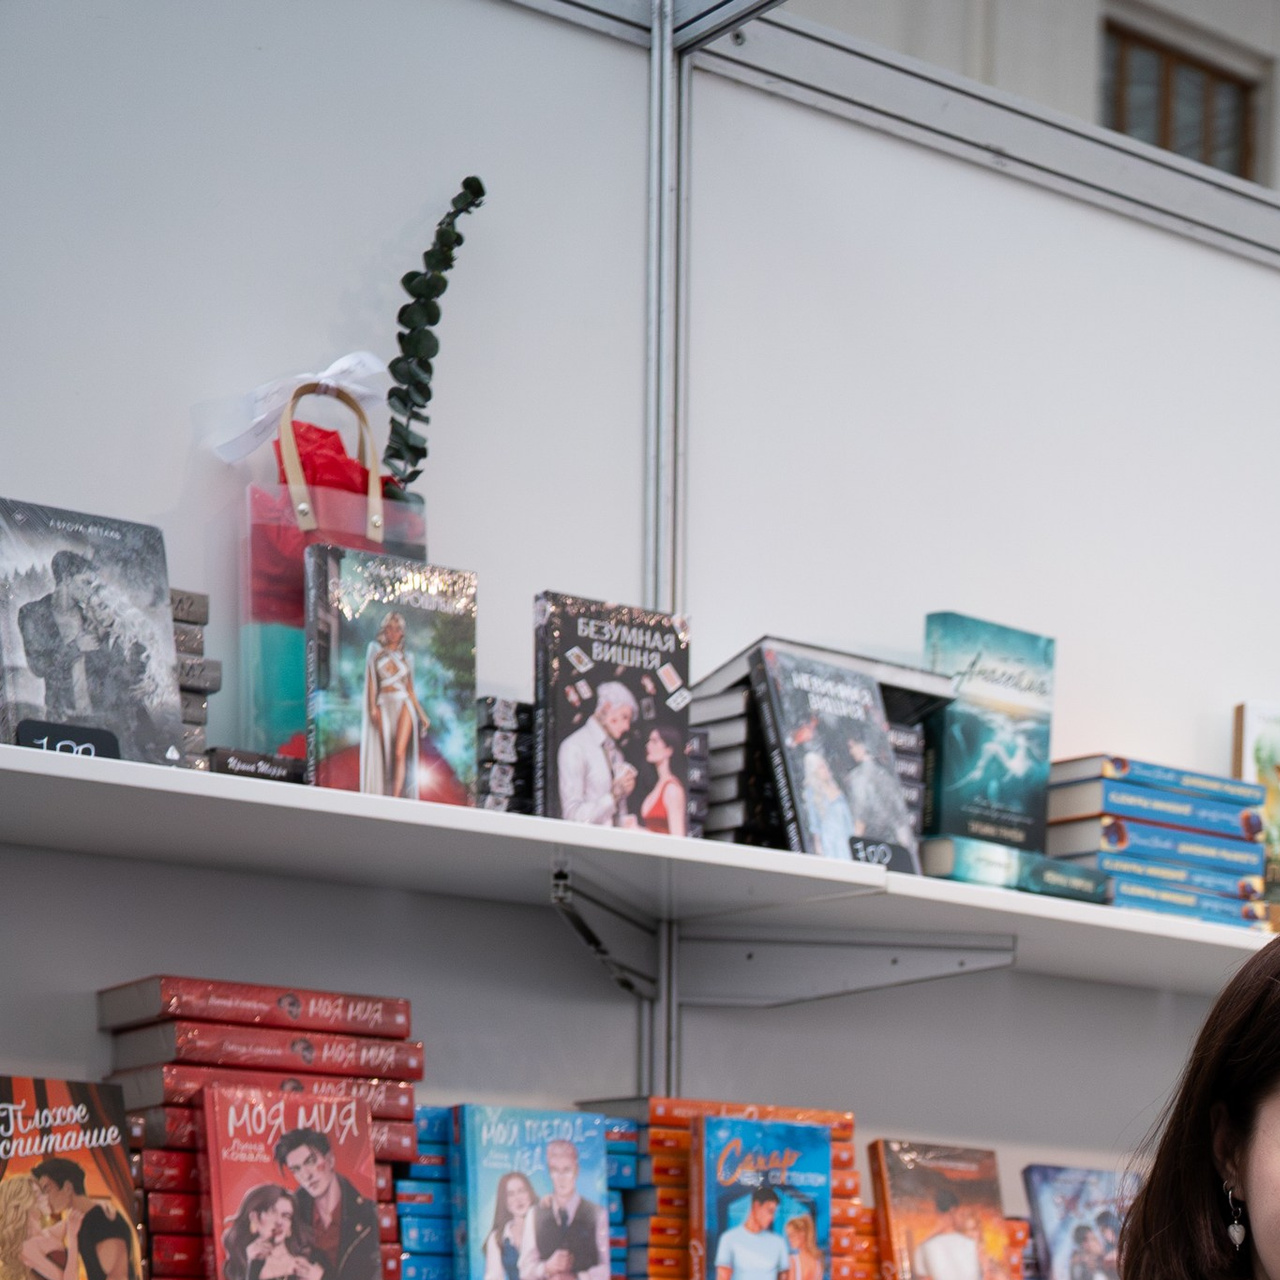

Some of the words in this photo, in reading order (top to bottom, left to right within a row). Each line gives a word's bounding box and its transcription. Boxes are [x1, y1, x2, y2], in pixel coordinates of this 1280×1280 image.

[577, 617, 677, 653] БЕЗУМНАЯ
[591, 641, 662, 671] ВИШНЯ
[228, 1100, 287, 1144] МОЯ
[297, 1100, 360, 1144] МИЯ
[717, 1138, 802, 1187] Сахар
